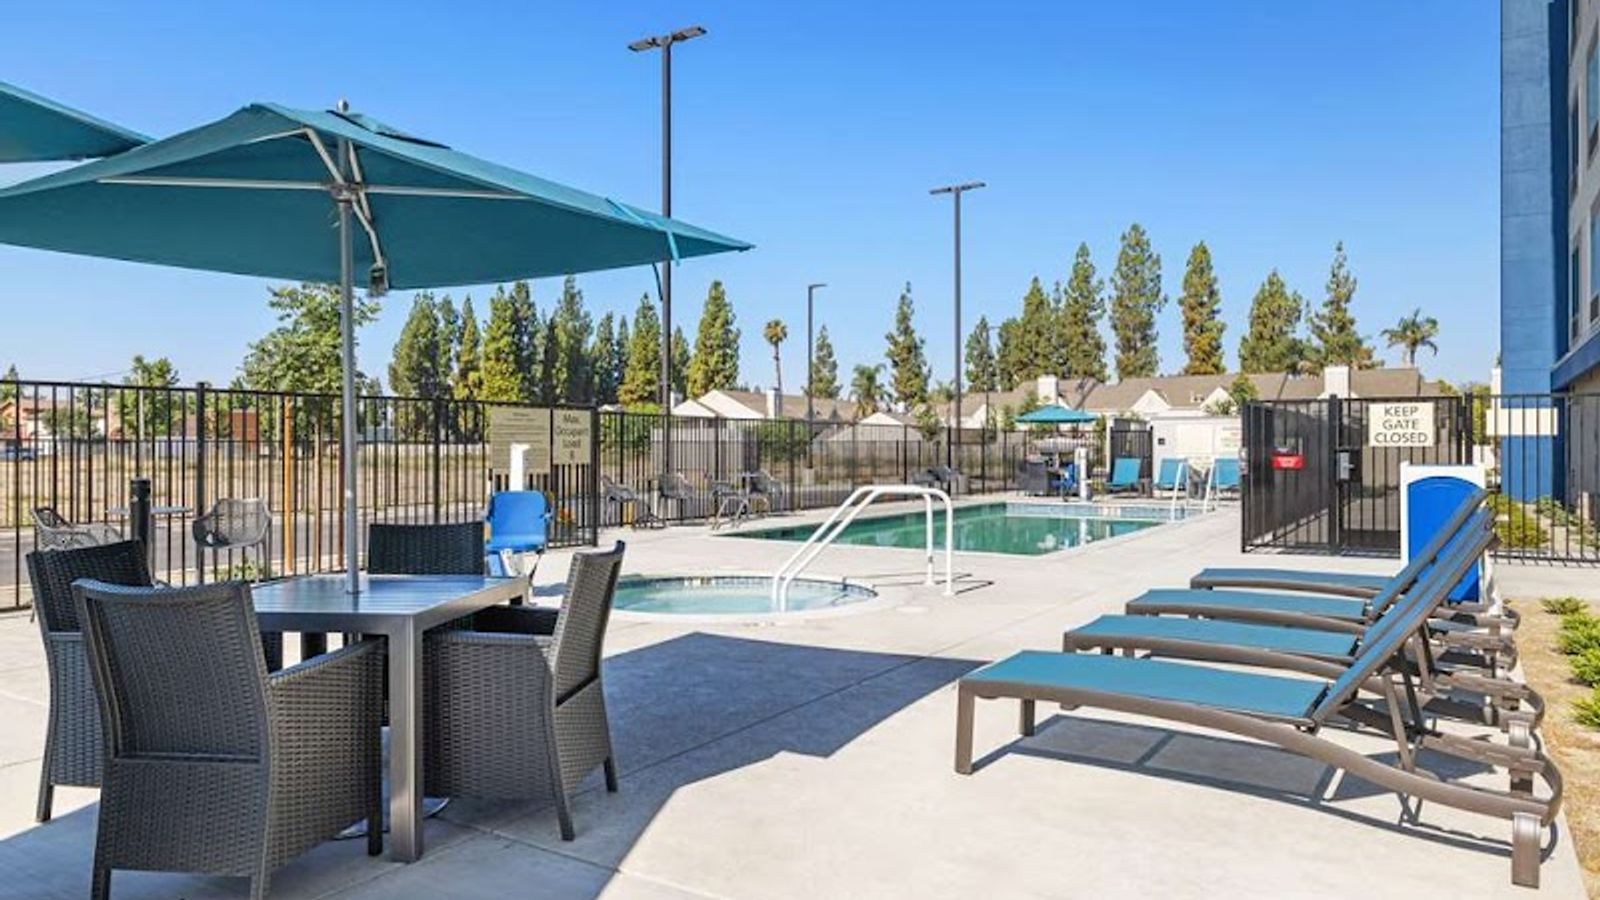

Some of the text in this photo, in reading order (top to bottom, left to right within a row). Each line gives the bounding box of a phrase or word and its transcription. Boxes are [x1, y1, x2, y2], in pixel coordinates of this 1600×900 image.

[1384, 406, 1419, 417] KEEP
[1382, 419, 1419, 430] GATE
[1374, 432, 1428, 443] CLOSED
